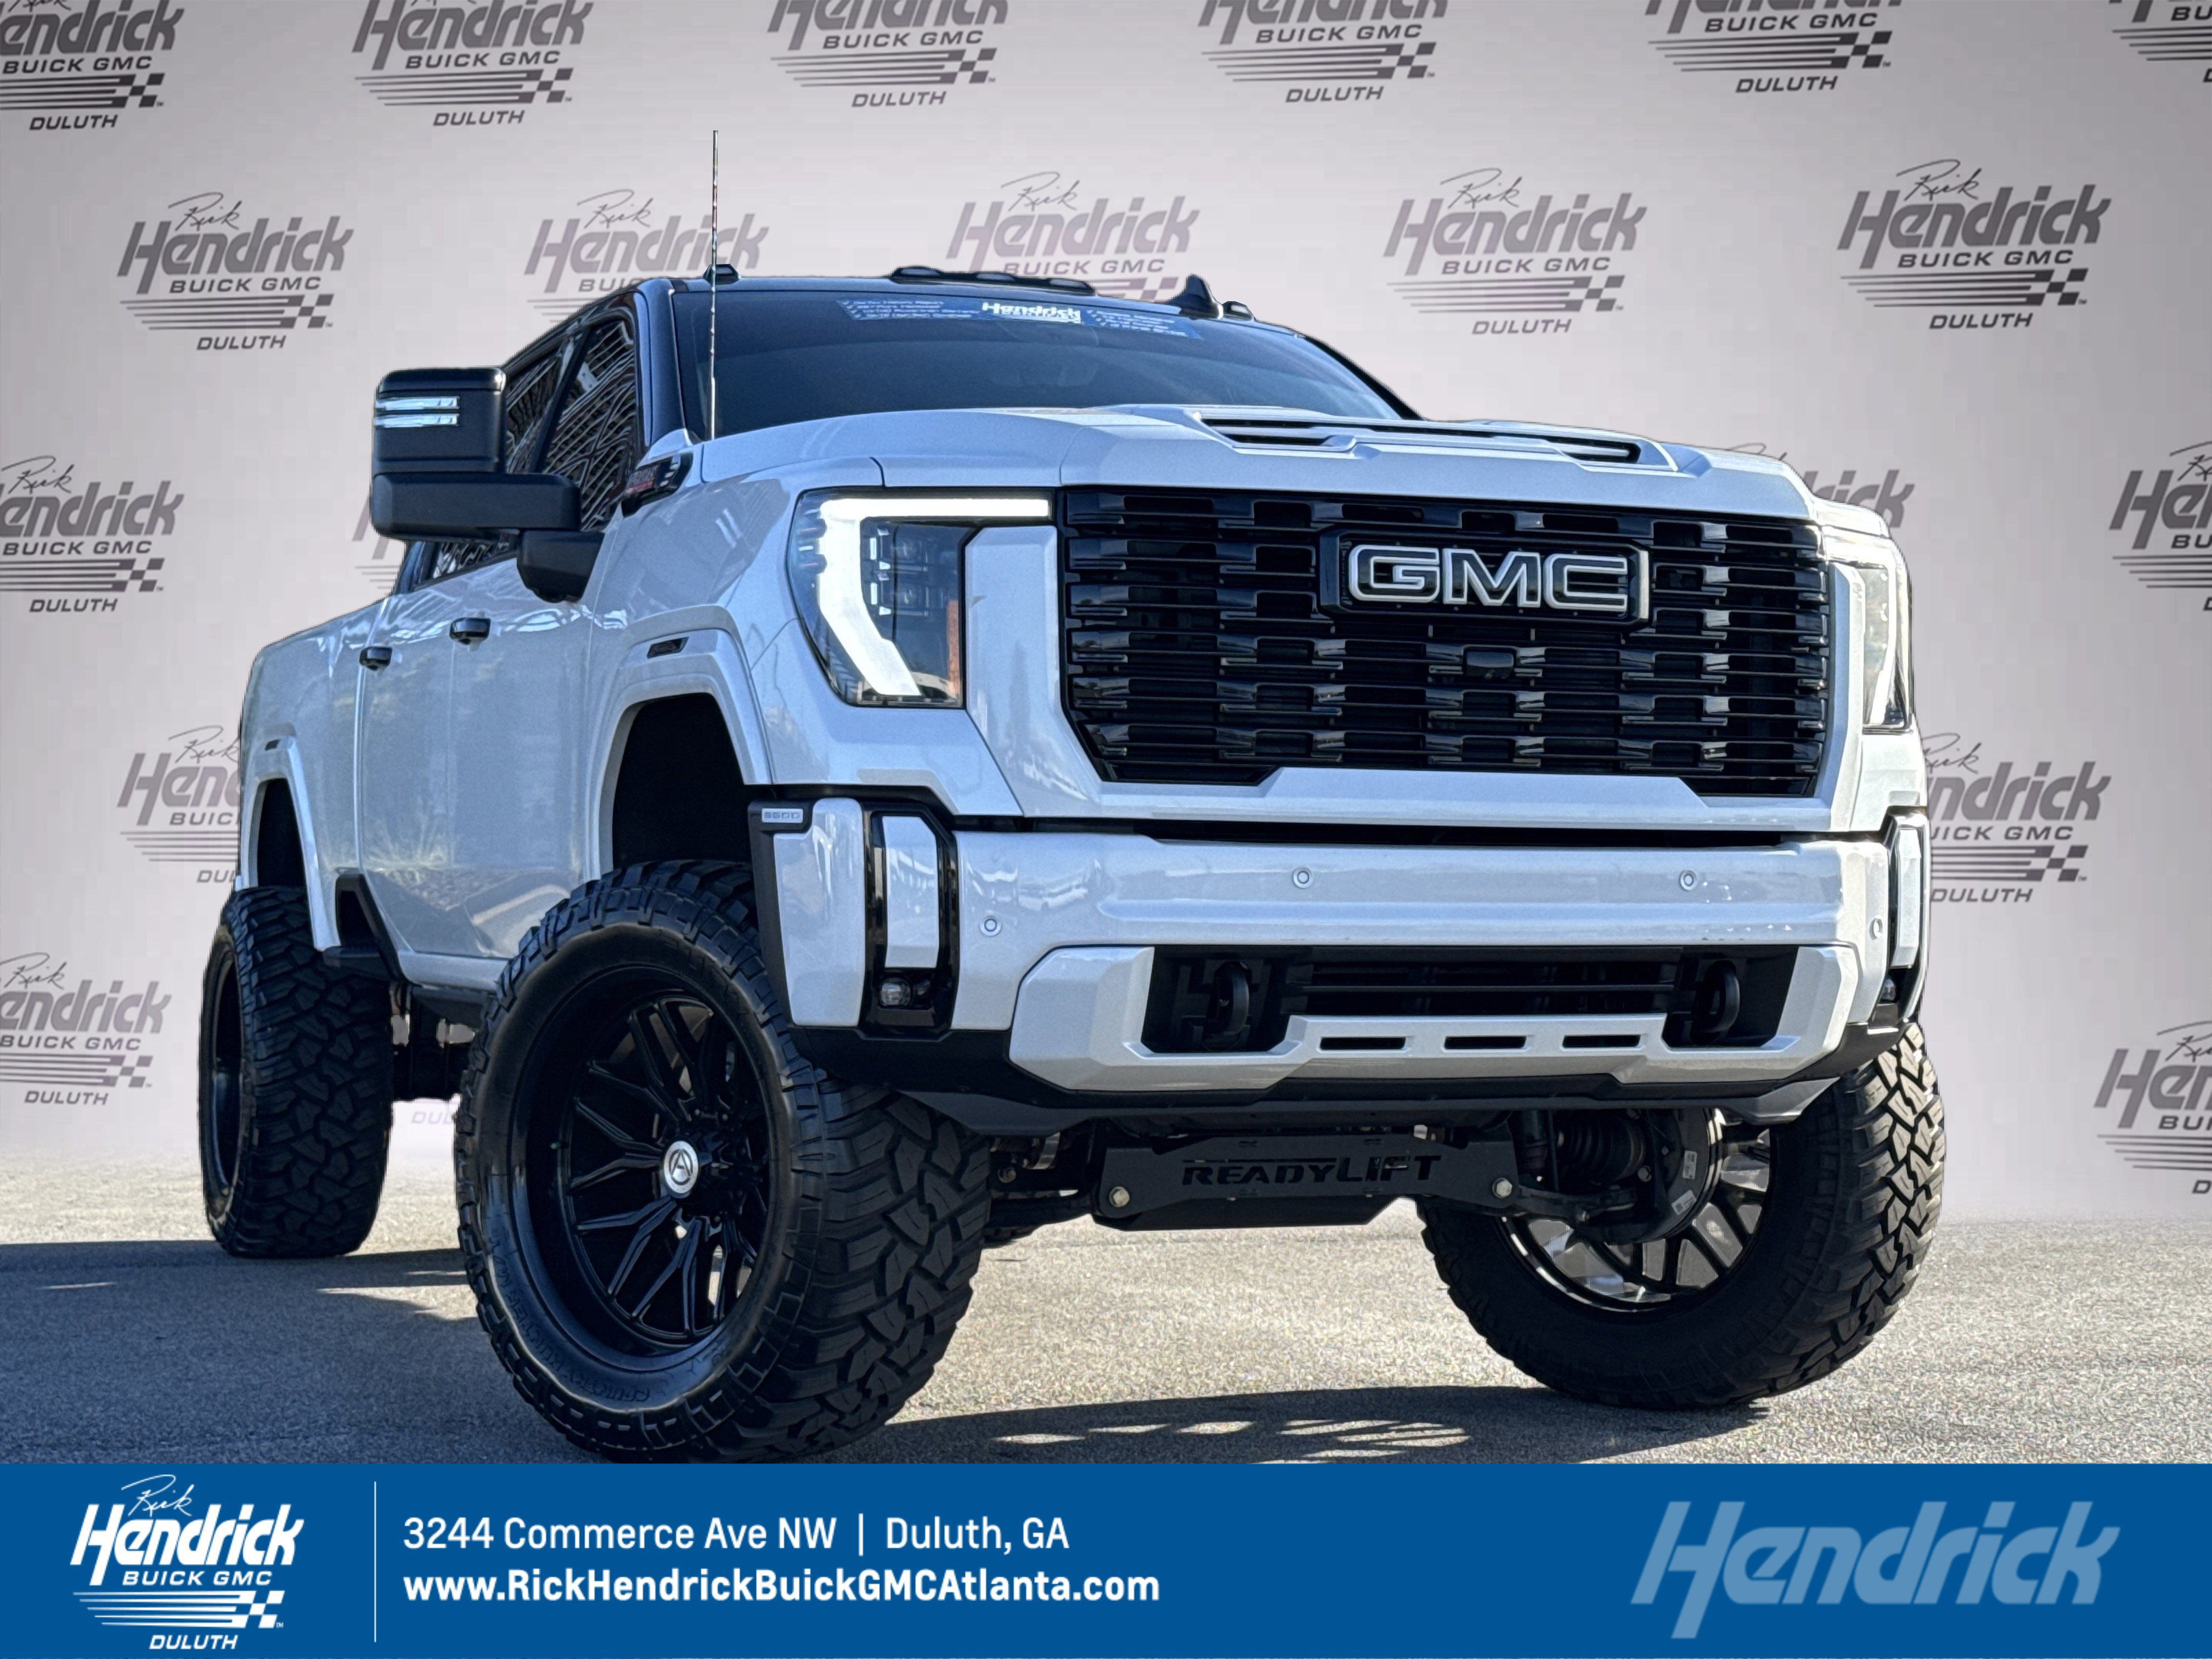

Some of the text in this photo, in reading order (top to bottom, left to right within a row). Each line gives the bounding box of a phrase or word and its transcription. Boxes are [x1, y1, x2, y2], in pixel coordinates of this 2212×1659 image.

[0, 0, 185, 56] endrick
[1704, 12, 1878, 32] BUICK GMC
[352, 0, 594, 71] Hendrick
[822, 30, 984, 50] BUICK GMC
[1255, 24, 1423, 43] BUICK GMC
[2, 55, 153, 74] BUICK GMC
[405, 50, 561, 69] BUICK GMC
[1735, 75, 1839, 93] DULUTH
[851, 91, 947, 108] DULUTH
[1285, 86, 1385, 103] DULUTH
[29, 114, 119, 131] DULUTH
[432, 110, 526, 126] DULUTH
[945, 195, 1200, 273] Hendrick
[1383, 192, 1648, 276] Hendrick
[1836, 184, 2112, 270] Hendrick
[117, 215, 354, 295] Hendrick
[524, 213, 770, 294] Hendrick
[1897, 250, 2074, 268] BUICK GMC
[1003, 258, 1166, 275] BUICK GMC
[1441, 257, 1611, 275] BUICK GMC
[169, 276, 322, 294] BUICK GMC
[1471, 319, 1572, 335] DULUTH
[1929, 313, 2034, 330] DULUTH
[196, 335, 287, 351] DULUTH
[0, 480, 184, 538] endrick
[3, 540, 153, 556] BUICK GMC
[1348, 544, 1629, 610] GMC
[29, 598, 118, 613] DULUTH
[1927, 761, 2112, 821] ndrick
[169, 812, 239, 826] BUIC
[1930, 826, 2074, 840] ICK GMC
[1931, 888, 2034, 902] DULUTH
[0, 979, 172, 1034] endrick
[0, 1035, 142, 1051] BUICK GMC
[24, 1091, 109, 1105] DULUTH
[411, 1111, 454, 1125] DUL
[1182, 1154, 1442, 1186] READYLIFT
